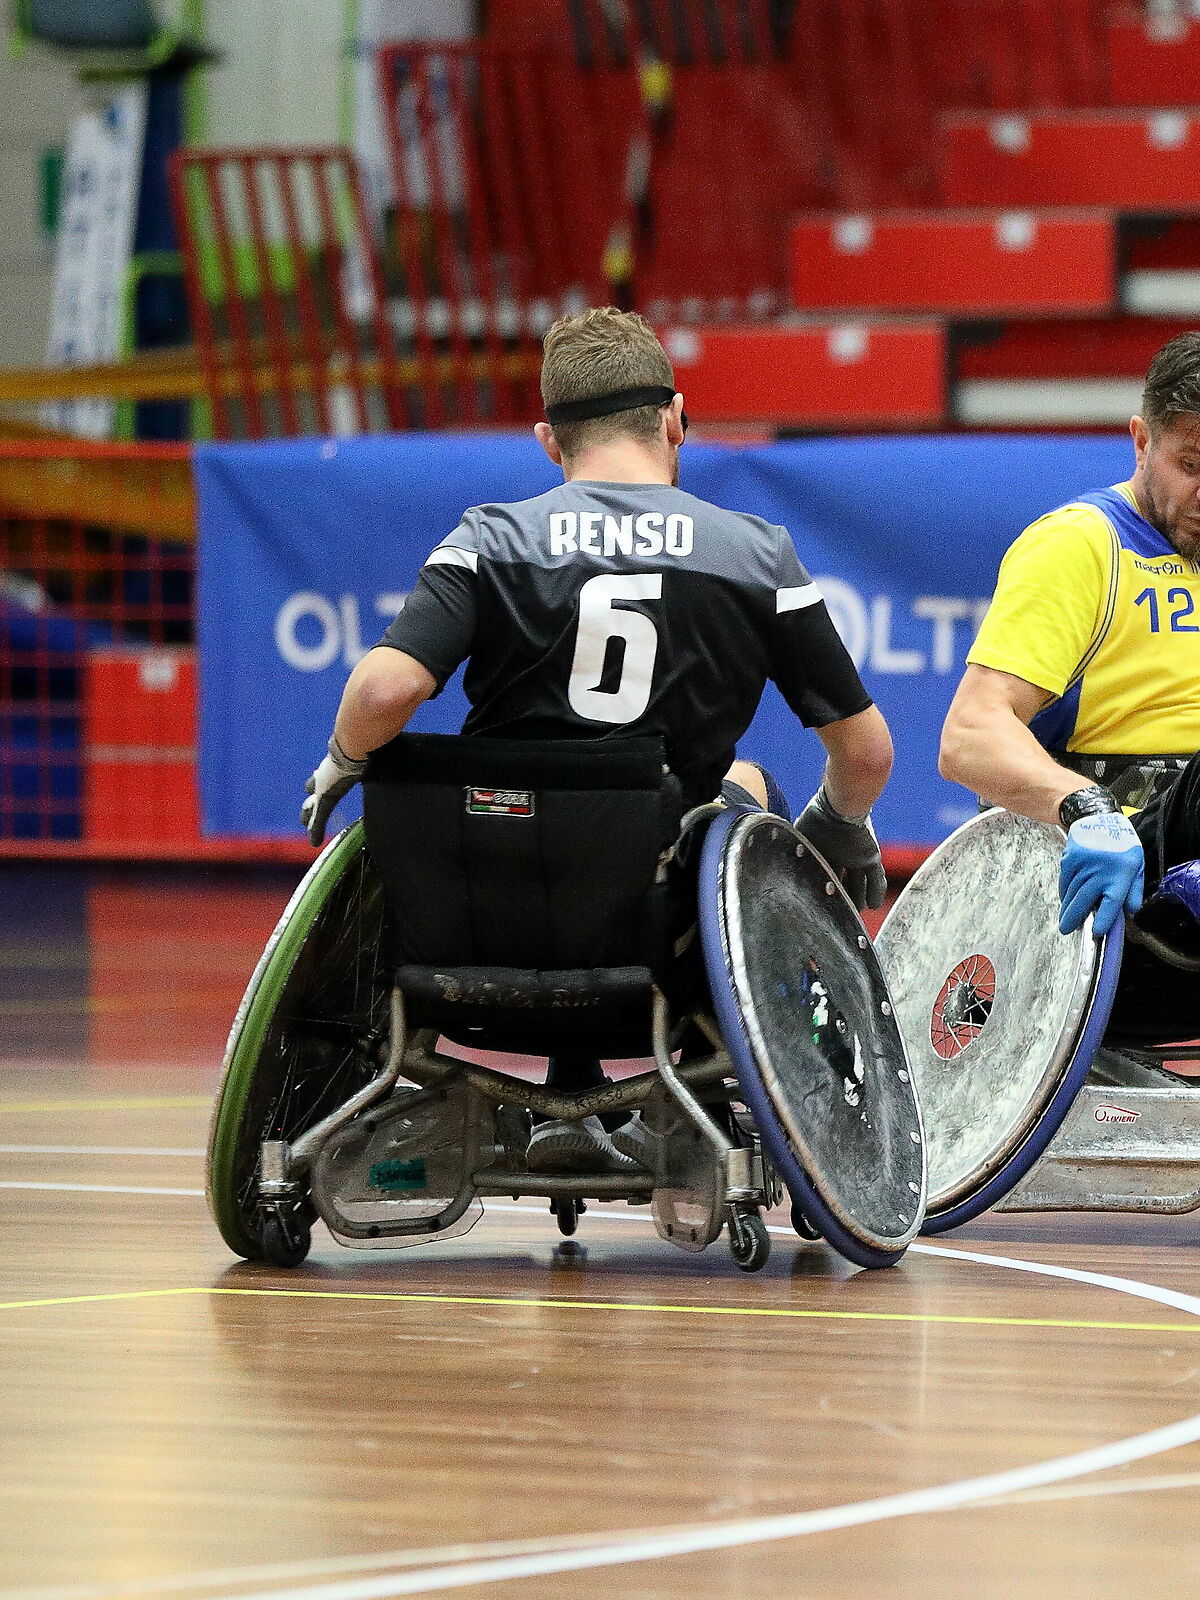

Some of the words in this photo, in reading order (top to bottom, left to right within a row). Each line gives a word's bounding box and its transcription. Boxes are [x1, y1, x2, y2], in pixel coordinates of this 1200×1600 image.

[550, 511, 694, 557] RENSO
[1134, 560, 1183, 575] macron
[1134, 588, 1200, 633] 12
[567, 573, 663, 724] 6
